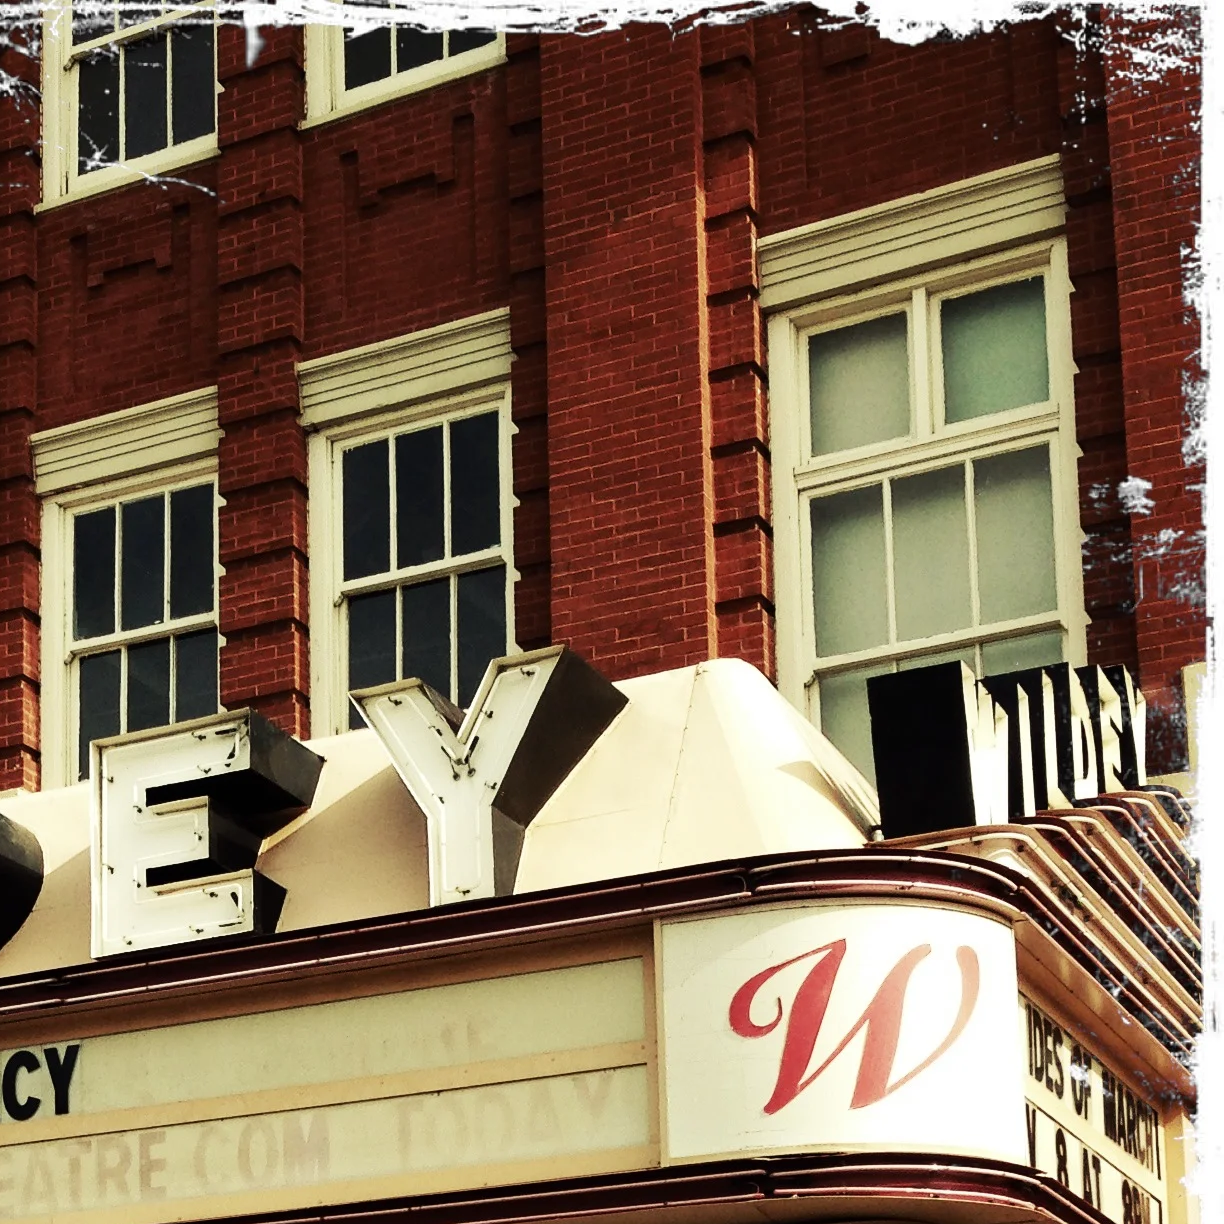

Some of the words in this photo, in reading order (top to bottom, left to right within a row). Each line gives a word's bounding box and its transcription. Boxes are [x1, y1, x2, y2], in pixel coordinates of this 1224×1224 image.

[729, 938, 980, 1115] W
[1025, 1002, 1065, 1100] IDES
[1101, 1066, 1154, 1174] MARCH
[1082, 1147, 1102, 1212] AT
